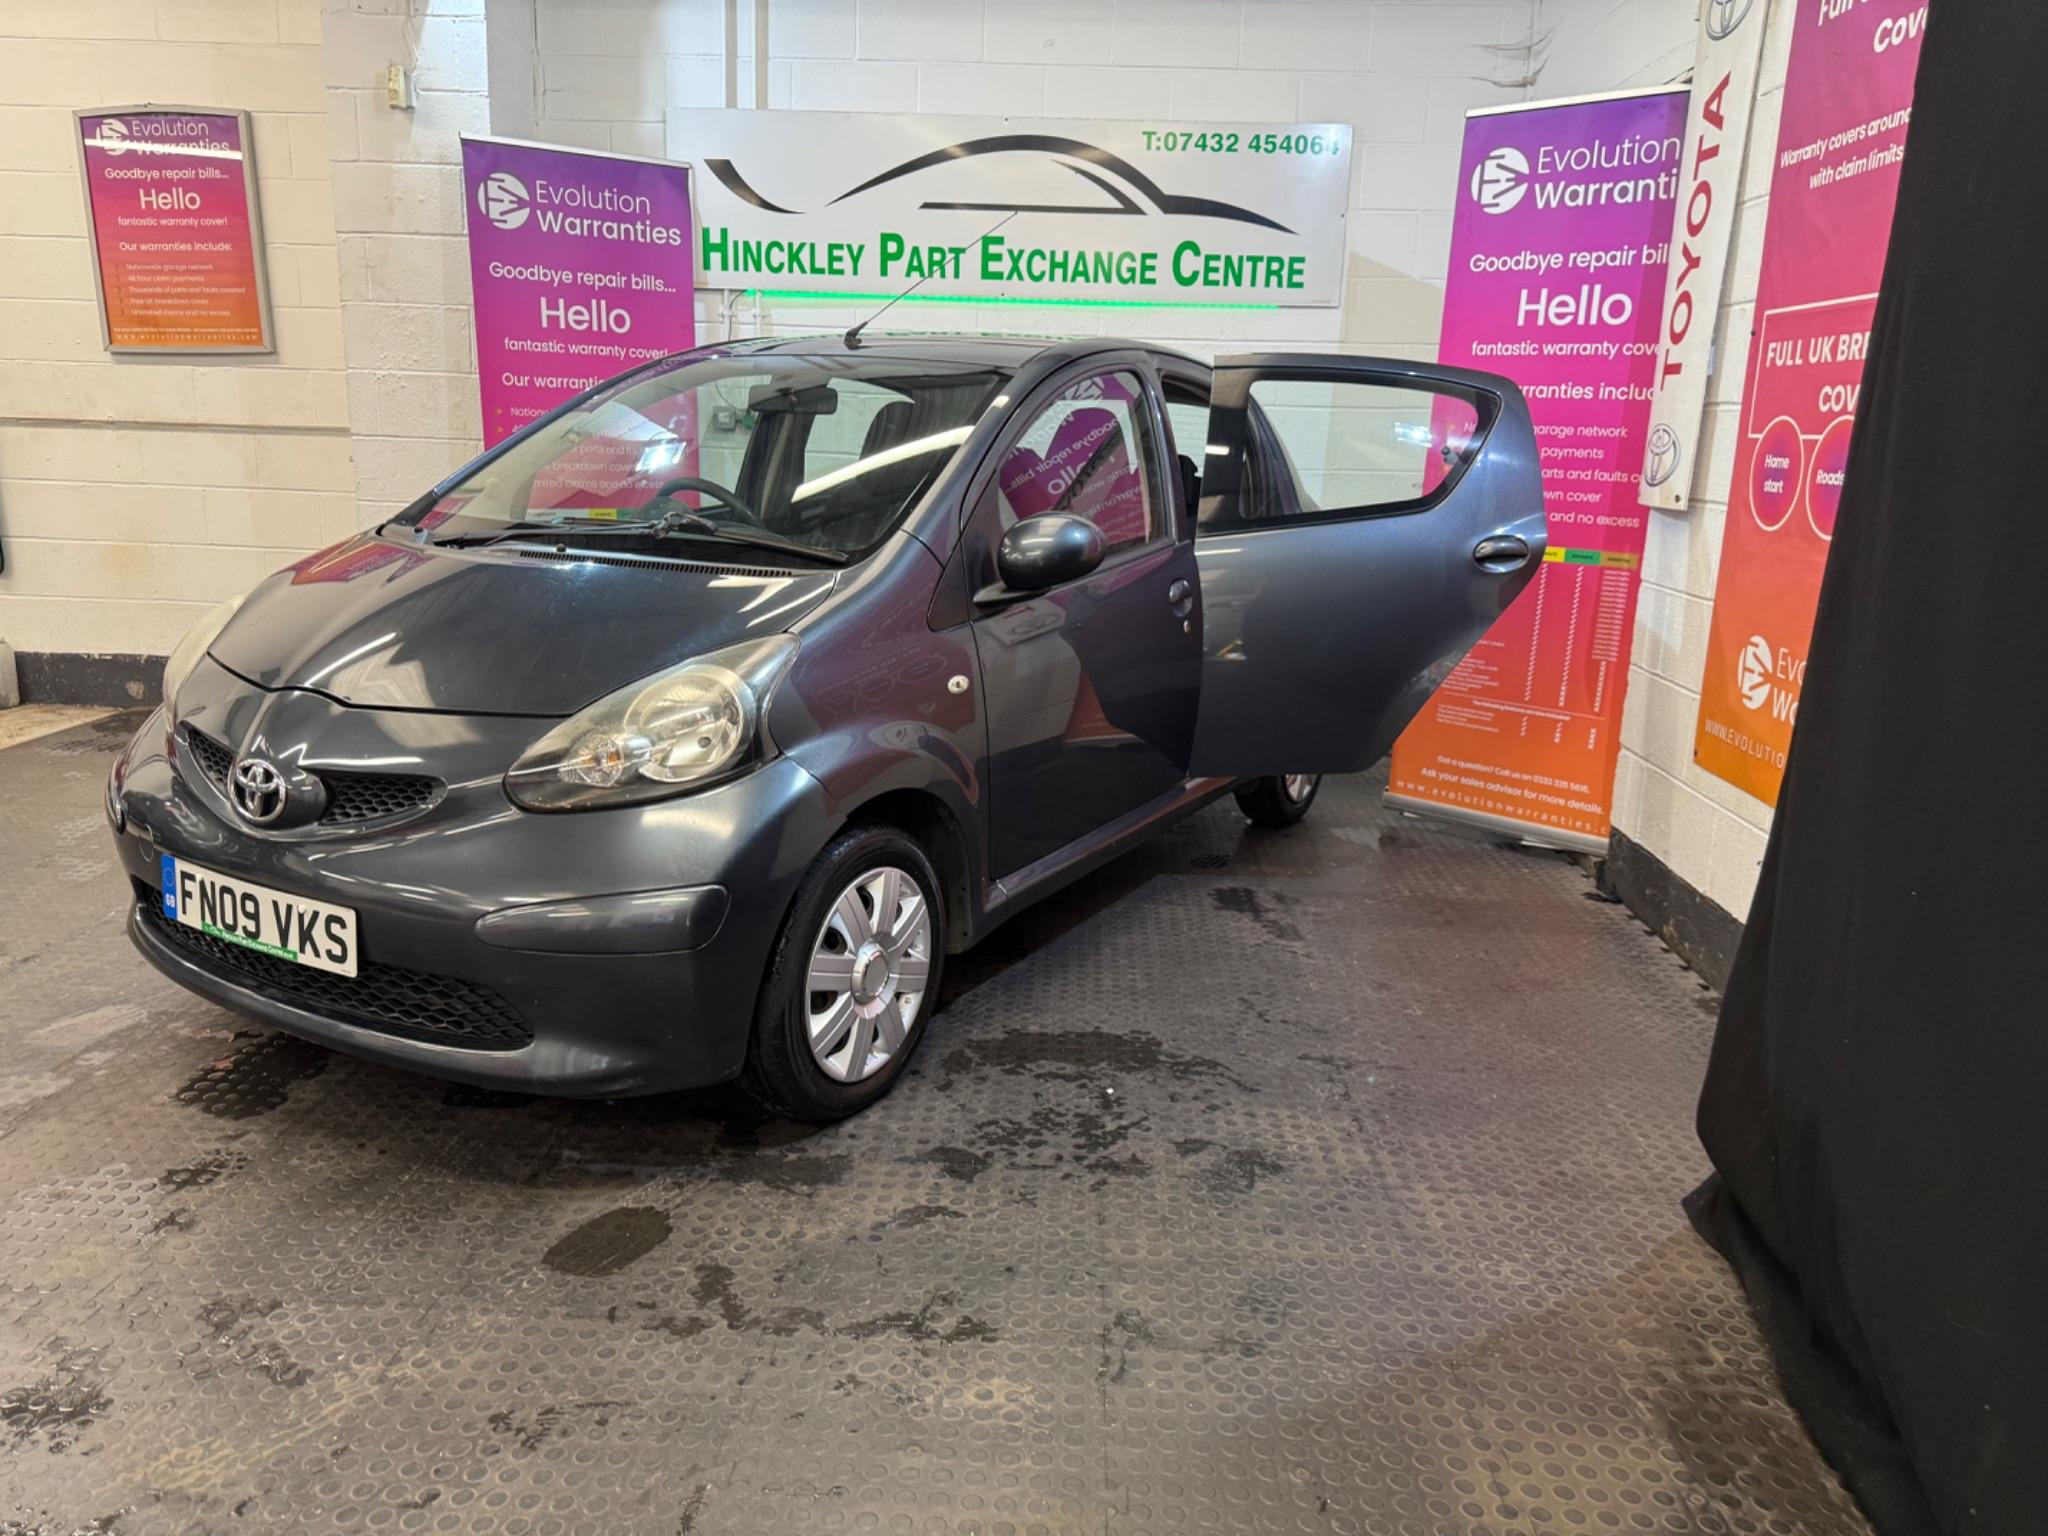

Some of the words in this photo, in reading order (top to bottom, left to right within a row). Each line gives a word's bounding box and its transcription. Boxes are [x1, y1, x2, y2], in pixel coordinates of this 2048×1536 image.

[1818, 0, 1853, 26] Fu
[1874, 7, 1928, 53] Cov
[132, 120, 209, 136] Evolution
[1142, 131, 1239, 153] T:07432
[1780, 139, 1828, 168] Warranty
[1828, 123, 1867, 151] covers
[1537, 135, 1681, 175] Evolution
[1809, 164, 1834, 189] with
[1835, 156, 1867, 181] claim
[1868, 143, 1905, 171] limits
[104, 167, 160, 183] Goodbye
[162, 168, 195, 181] repair
[139, 187, 201, 210] Hello
[535, 180, 650, 215] Evolution
[1534, 168, 1678, 210] Warranti
[118, 216, 158, 226] fantastic
[159, 217, 199, 228] warranty
[200, 216, 228, 226] cover!
[536, 209, 682, 246] Warranties
[1661, 70, 1731, 391] TOYOTA
[119, 242, 137, 251] Our
[140, 241, 192, 251] warranties
[701, 226, 866, 277] HINCKLEY
[880, 232, 966, 280] PART
[981, 235, 1158, 286] EXCHANGE
[1171, 240, 1306, 289] CENTRE
[1469, 250, 1563, 276] Goodbye
[1568, 245, 1637, 273] repair
[1641, 242, 1669, 265] bil
[488, 262, 572, 287] Goodbye
[577, 272, 628, 291] repair
[631, 274, 677, 293] bills...
[540, 297, 632, 334] Hello
[1516, 284, 1633, 327] Hello
[504, 337, 563, 354] fantastic
[567, 342, 626, 360] warranty
[1471, 340, 1539, 356] fantastic
[1543, 341, 1620, 360] warranty
[1622, 342, 1660, 356] cov
[1766, 338, 1803, 368] FULL
[1808, 335, 1836, 364] UK
[502, 372, 529, 387] Our
[533, 373, 604, 391] warranti
[1519, 382, 1594, 399] rranties
[1599, 382, 1655, 400] inclu
[1819, 384, 1862, 413] COV
[510, 407, 549, 418] Nation
[1577, 425, 1628, 438] network
[1540, 446, 1604, 461] payments
[1764, 453, 1790, 469] Home
[1541, 468, 1564, 479] arts
[1567, 469, 1591, 480] and
[1594, 469, 1628, 482] faults
[1764, 479, 1784, 493] start
[1816, 469, 1845, 486] Roads
[1567, 491, 1602, 503] cover
[1549, 511, 1575, 523] and
[1577, 514, 1594, 525] no
[1596, 514, 1640, 528] excess
[1420, 767, 1437, 779] Ask
[1438, 771, 1459, 783] your
[1460, 775, 1486, 788] sales
[1486, 781, 1522, 797] advisor
[1523, 788, 1537, 799] for
[1538, 793, 1566, 807] more
[1397, 780, 1608, 834] www.evolutionwarranties.c
[165, 893, 175, 908] GB
[180, 869, 260, 940] FN09
[272, 899, 348, 965] VKS
